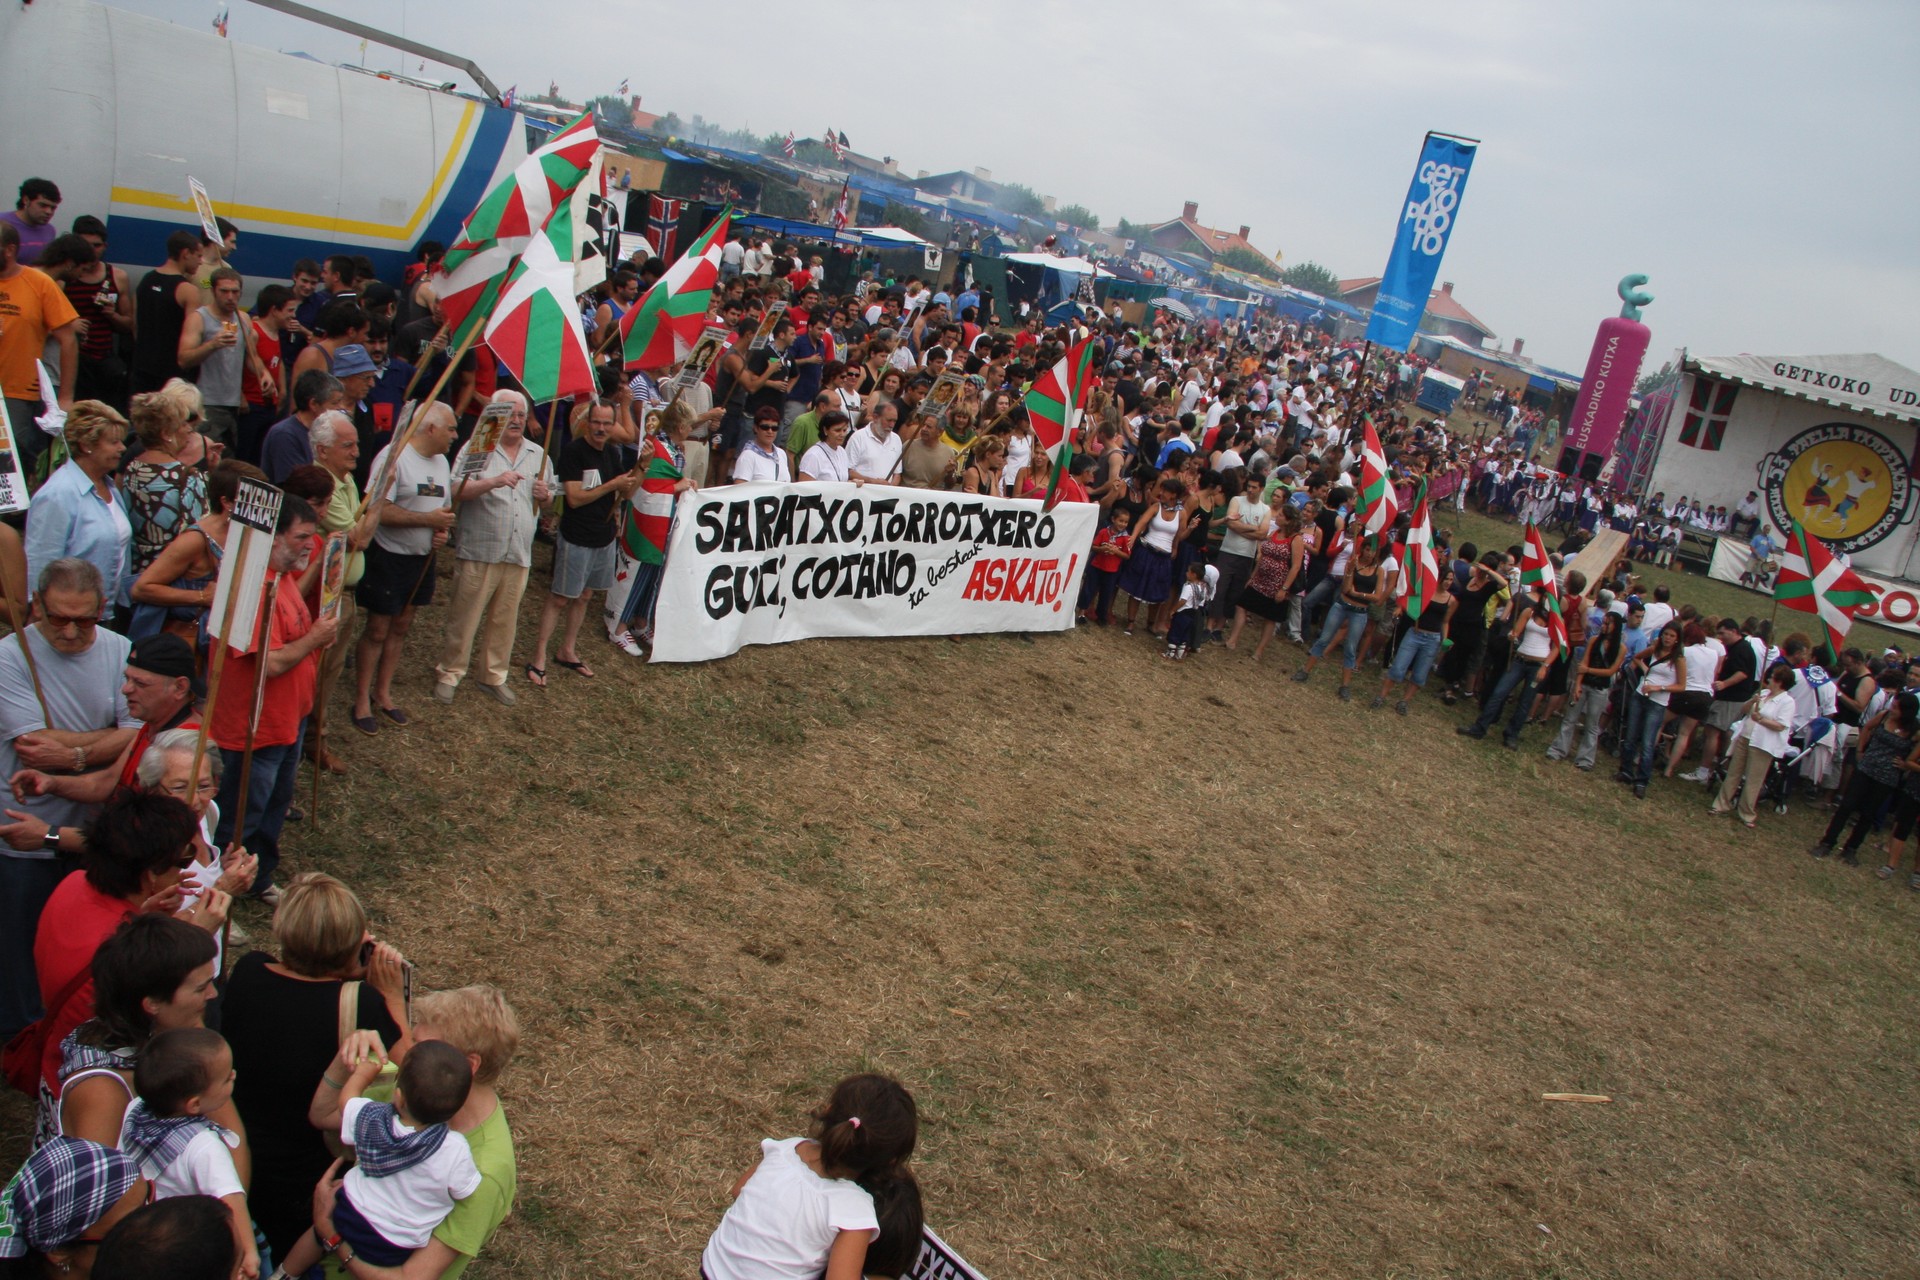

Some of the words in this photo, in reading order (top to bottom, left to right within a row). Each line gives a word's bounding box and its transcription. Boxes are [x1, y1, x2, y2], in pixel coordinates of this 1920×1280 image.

[1411, 231, 1443, 256] TO
[1576, 379, 1606, 449] EUSKADIKO
[1599, 336, 1620, 378] KUTXA
[1773, 362, 1871, 396] GETXOKO
[1888, 387, 1920, 408] UD
[1788, 426, 1850, 456] PAELLA
[694, 493, 868, 555] SARATXO,
[1857, 513, 1896, 546] GETXO
[792, 549, 917, 599] COTANO
[907, 590, 930, 610] ta
[926, 542, 984, 586] besteak
[961, 553, 1078, 613] ASKATU!
